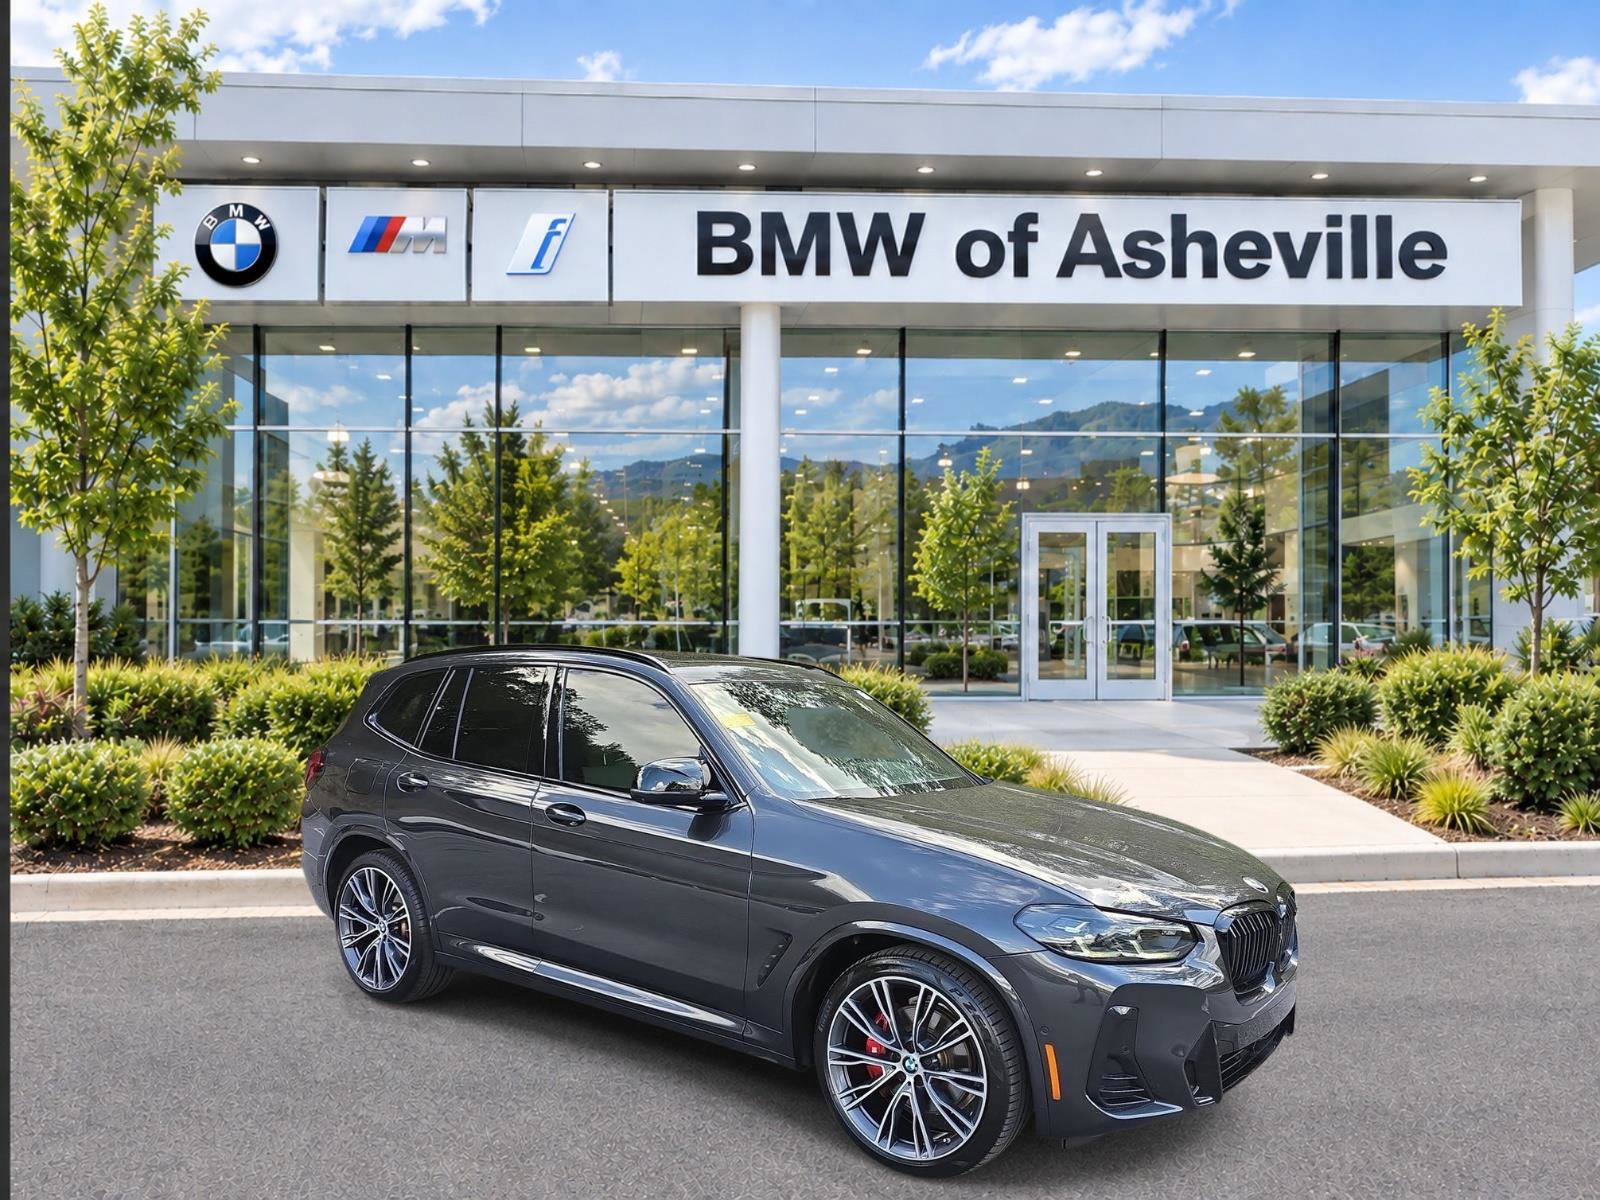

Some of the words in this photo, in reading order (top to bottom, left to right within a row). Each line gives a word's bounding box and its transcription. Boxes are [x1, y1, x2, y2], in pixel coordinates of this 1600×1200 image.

[203, 204, 271, 231] BMW
[696, 210, 926, 276] BMW
[955, 212, 1038, 278] of
[1056, 213, 1448, 279] Asheville
